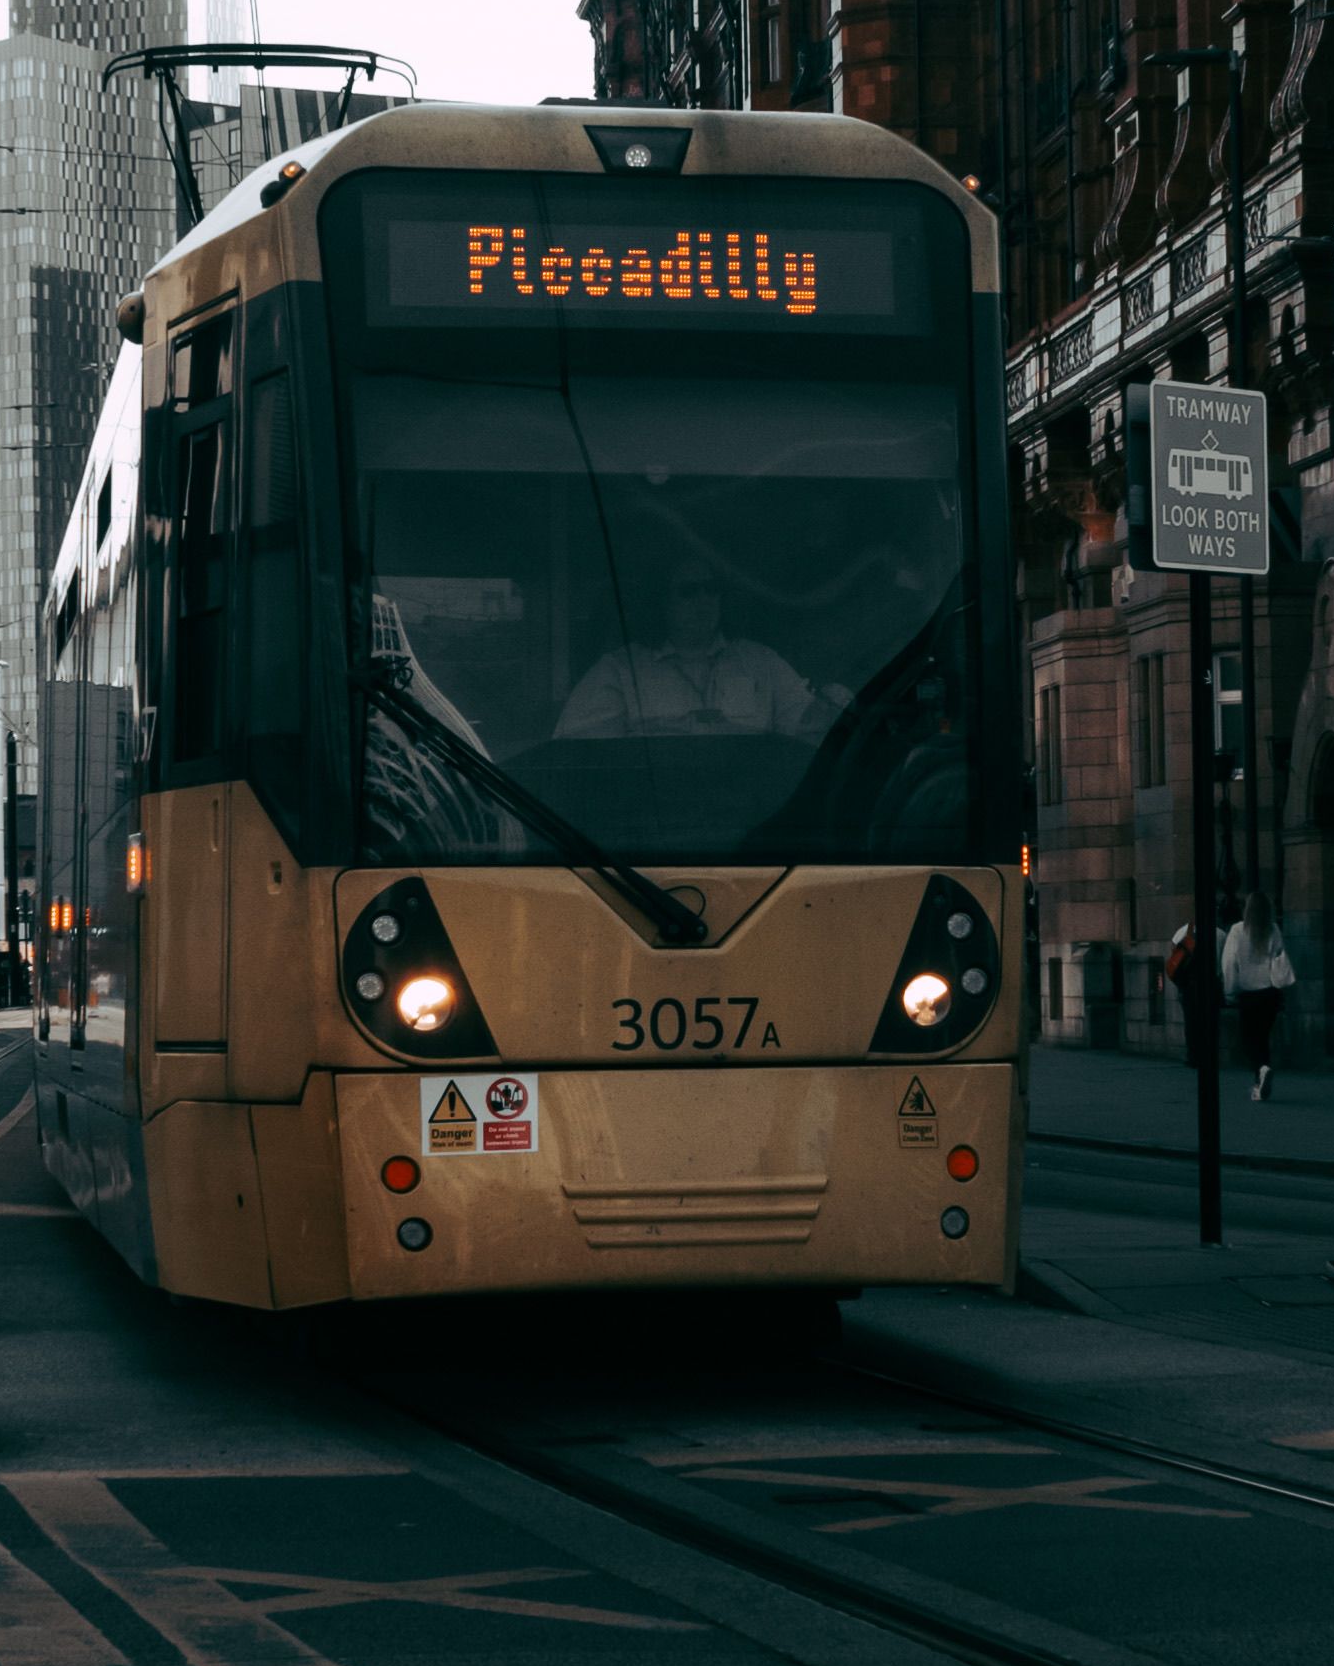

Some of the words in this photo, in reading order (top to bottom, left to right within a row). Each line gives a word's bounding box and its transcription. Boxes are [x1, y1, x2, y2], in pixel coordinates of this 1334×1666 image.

[469, 228, 816, 313] Piccadilly
[1166, 396, 1251, 425] TRAMWAY
[1162, 504, 1209, 529] LOOK
[1214, 509, 1260, 533] BOTH
[1187, 534, 1236, 558] WAYS
[431, 1129, 473, 1140] Danger
[903, 1123, 933, 1134] Danger
